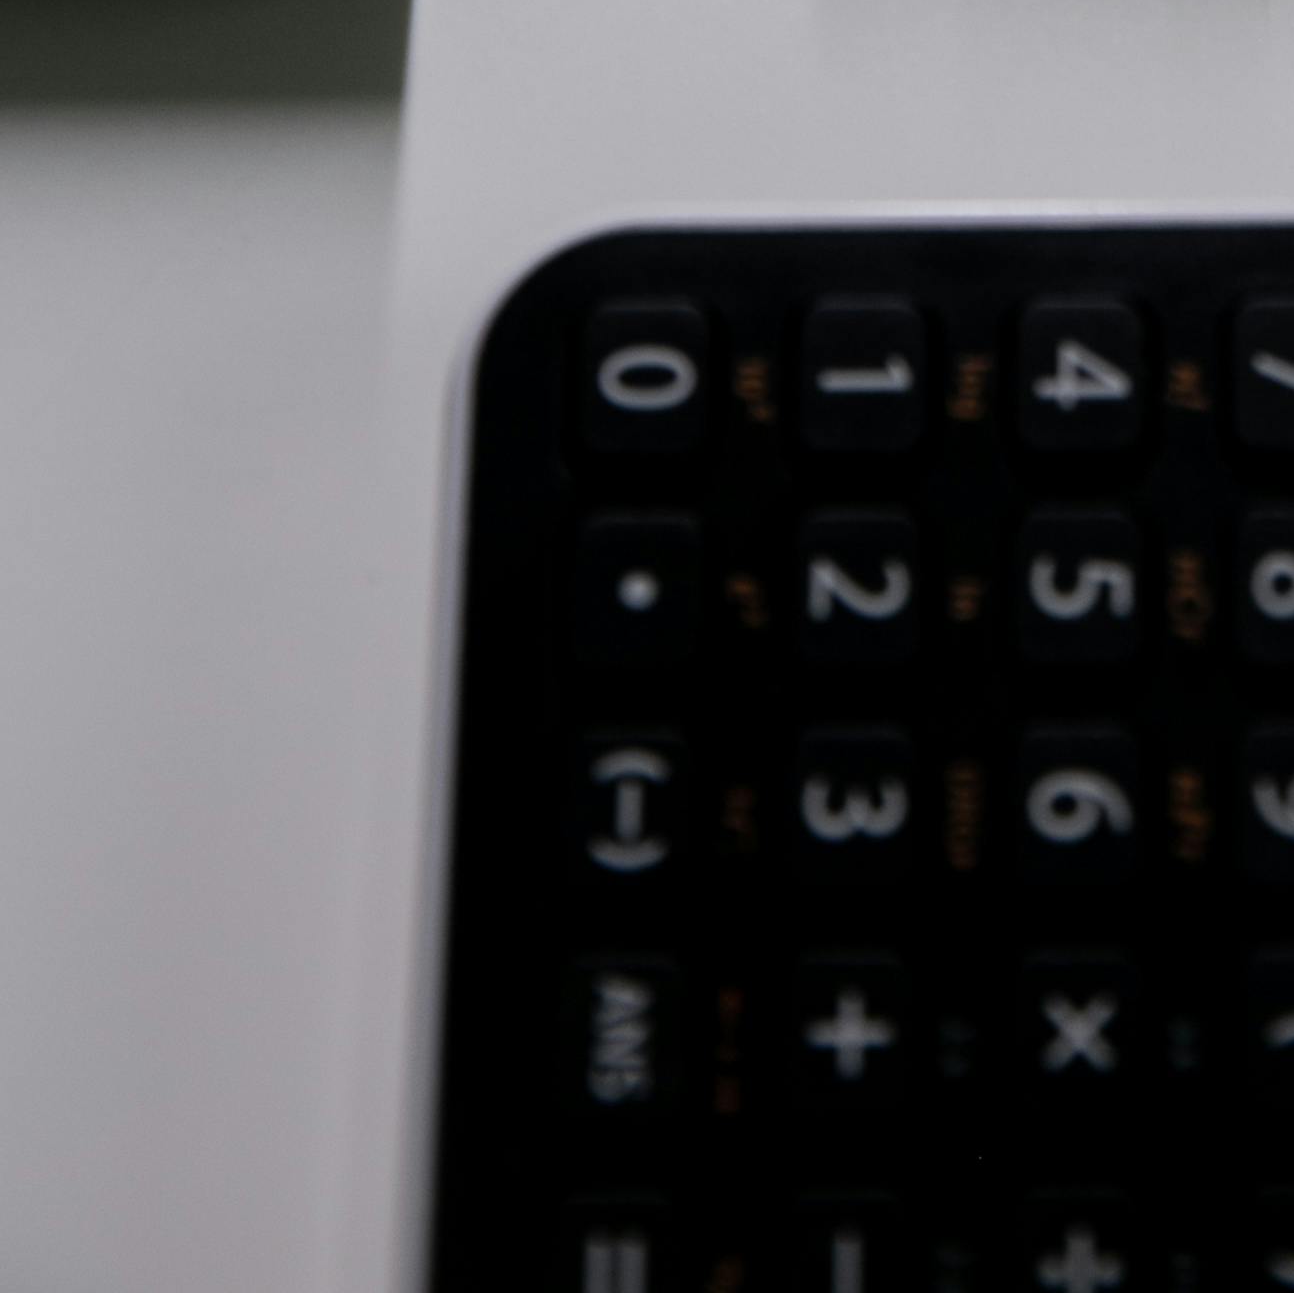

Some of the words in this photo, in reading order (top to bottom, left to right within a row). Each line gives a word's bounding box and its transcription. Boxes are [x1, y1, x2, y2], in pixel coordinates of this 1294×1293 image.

[593, 342, 698, 413] 0
[813, 353, 912, 397] 1
[1030, 339, 1131, 409] 4
[803, 554, 906, 623] 2
[1026, 552, 1135, 621] 5
[798, 774, 906, 844] 3
[1023, 763, 1133, 842] 6
[583, 973, 655, 1104] ANS
